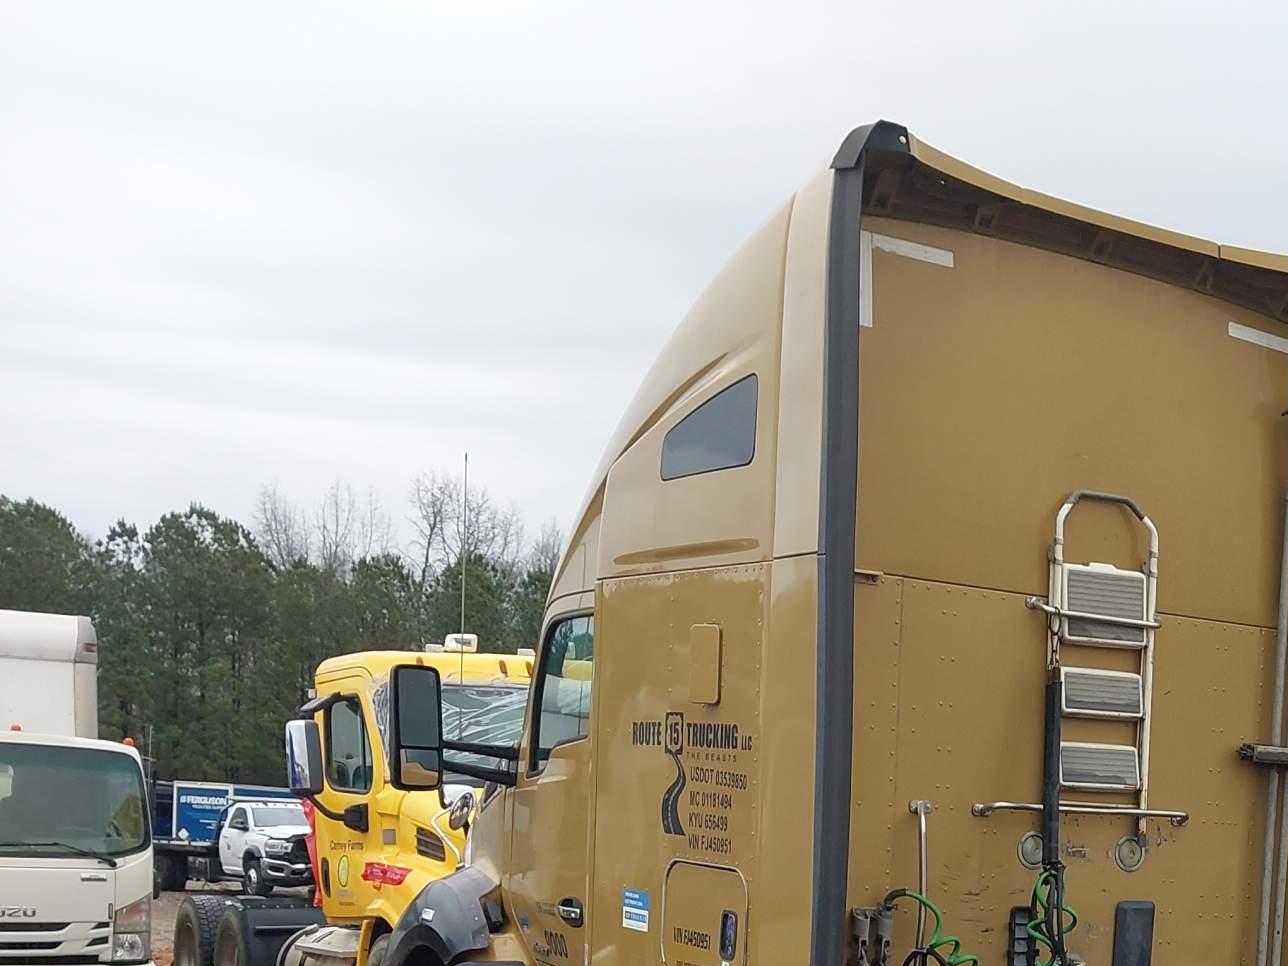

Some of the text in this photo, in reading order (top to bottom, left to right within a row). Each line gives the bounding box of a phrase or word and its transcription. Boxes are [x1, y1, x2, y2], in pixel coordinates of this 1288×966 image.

[632, 721, 752, 751] ROUTE 15 TRUCKING LLC
[690, 766, 714, 784] USDOT
[187, 795, 227, 805] FERGUSON
[689, 790, 700, 807] MC
[688, 811, 703, 829] KYU
[688, 833, 700, 850] VIN
